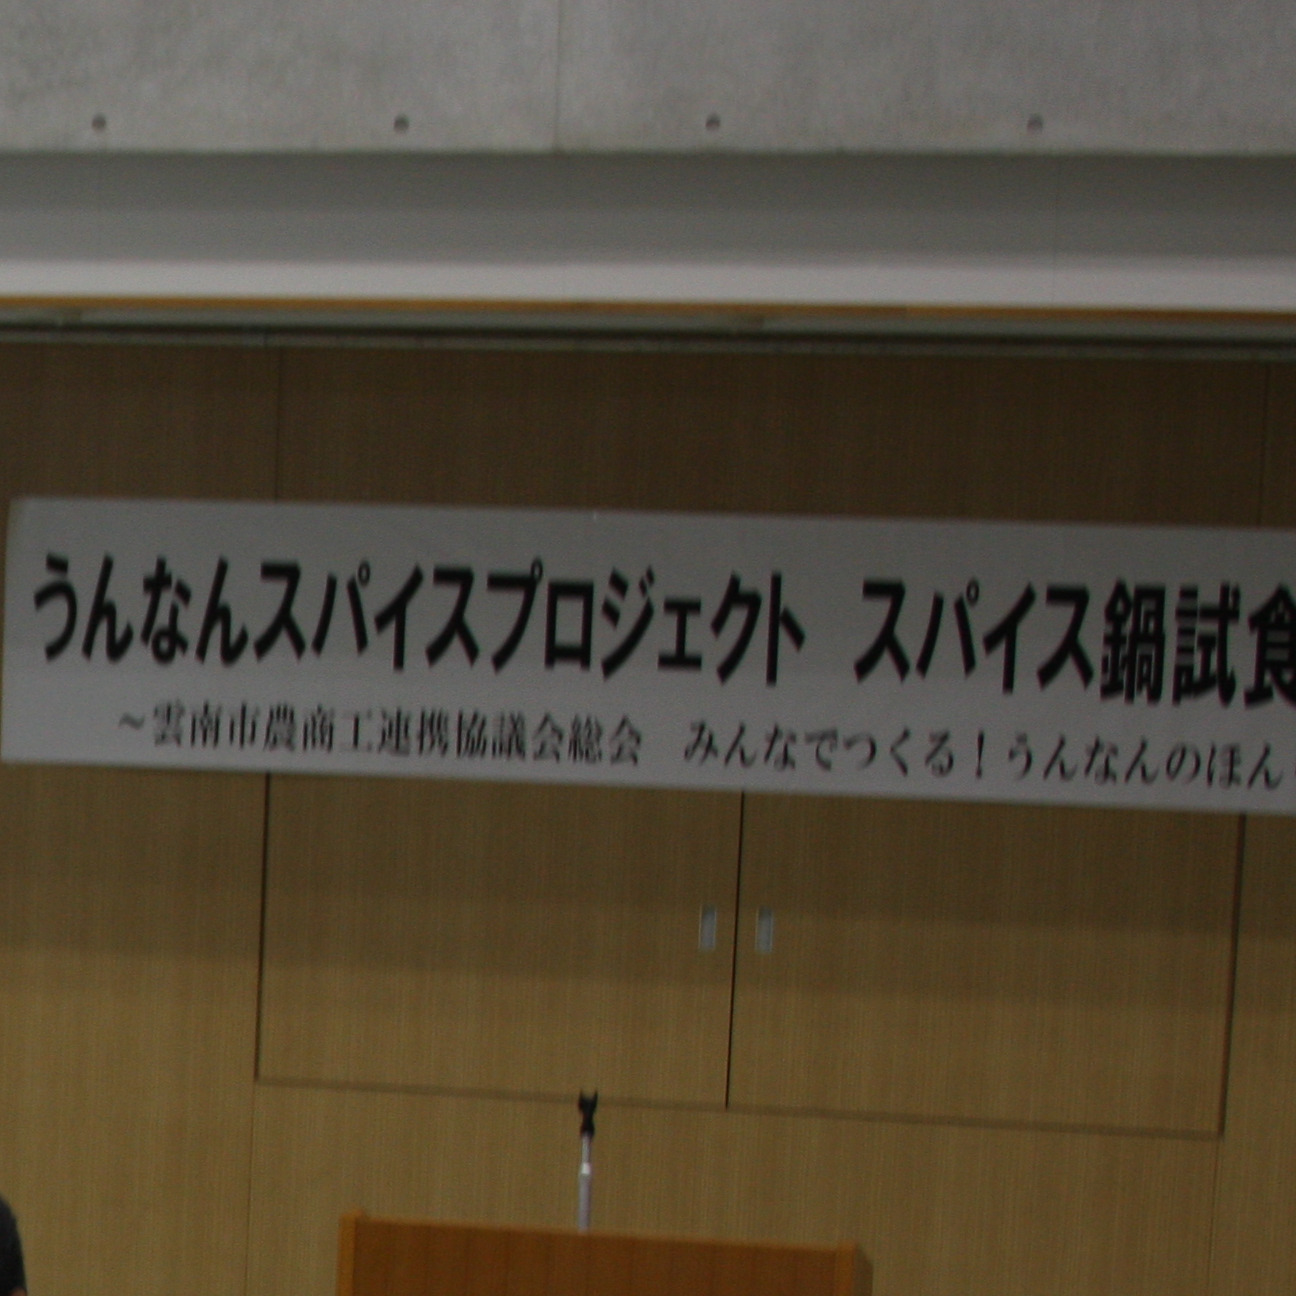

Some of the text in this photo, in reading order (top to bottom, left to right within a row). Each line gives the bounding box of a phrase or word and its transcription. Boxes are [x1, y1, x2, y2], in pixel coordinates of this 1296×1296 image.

[34, 553, 806, 688] うんなんスパイスプロジェクト
